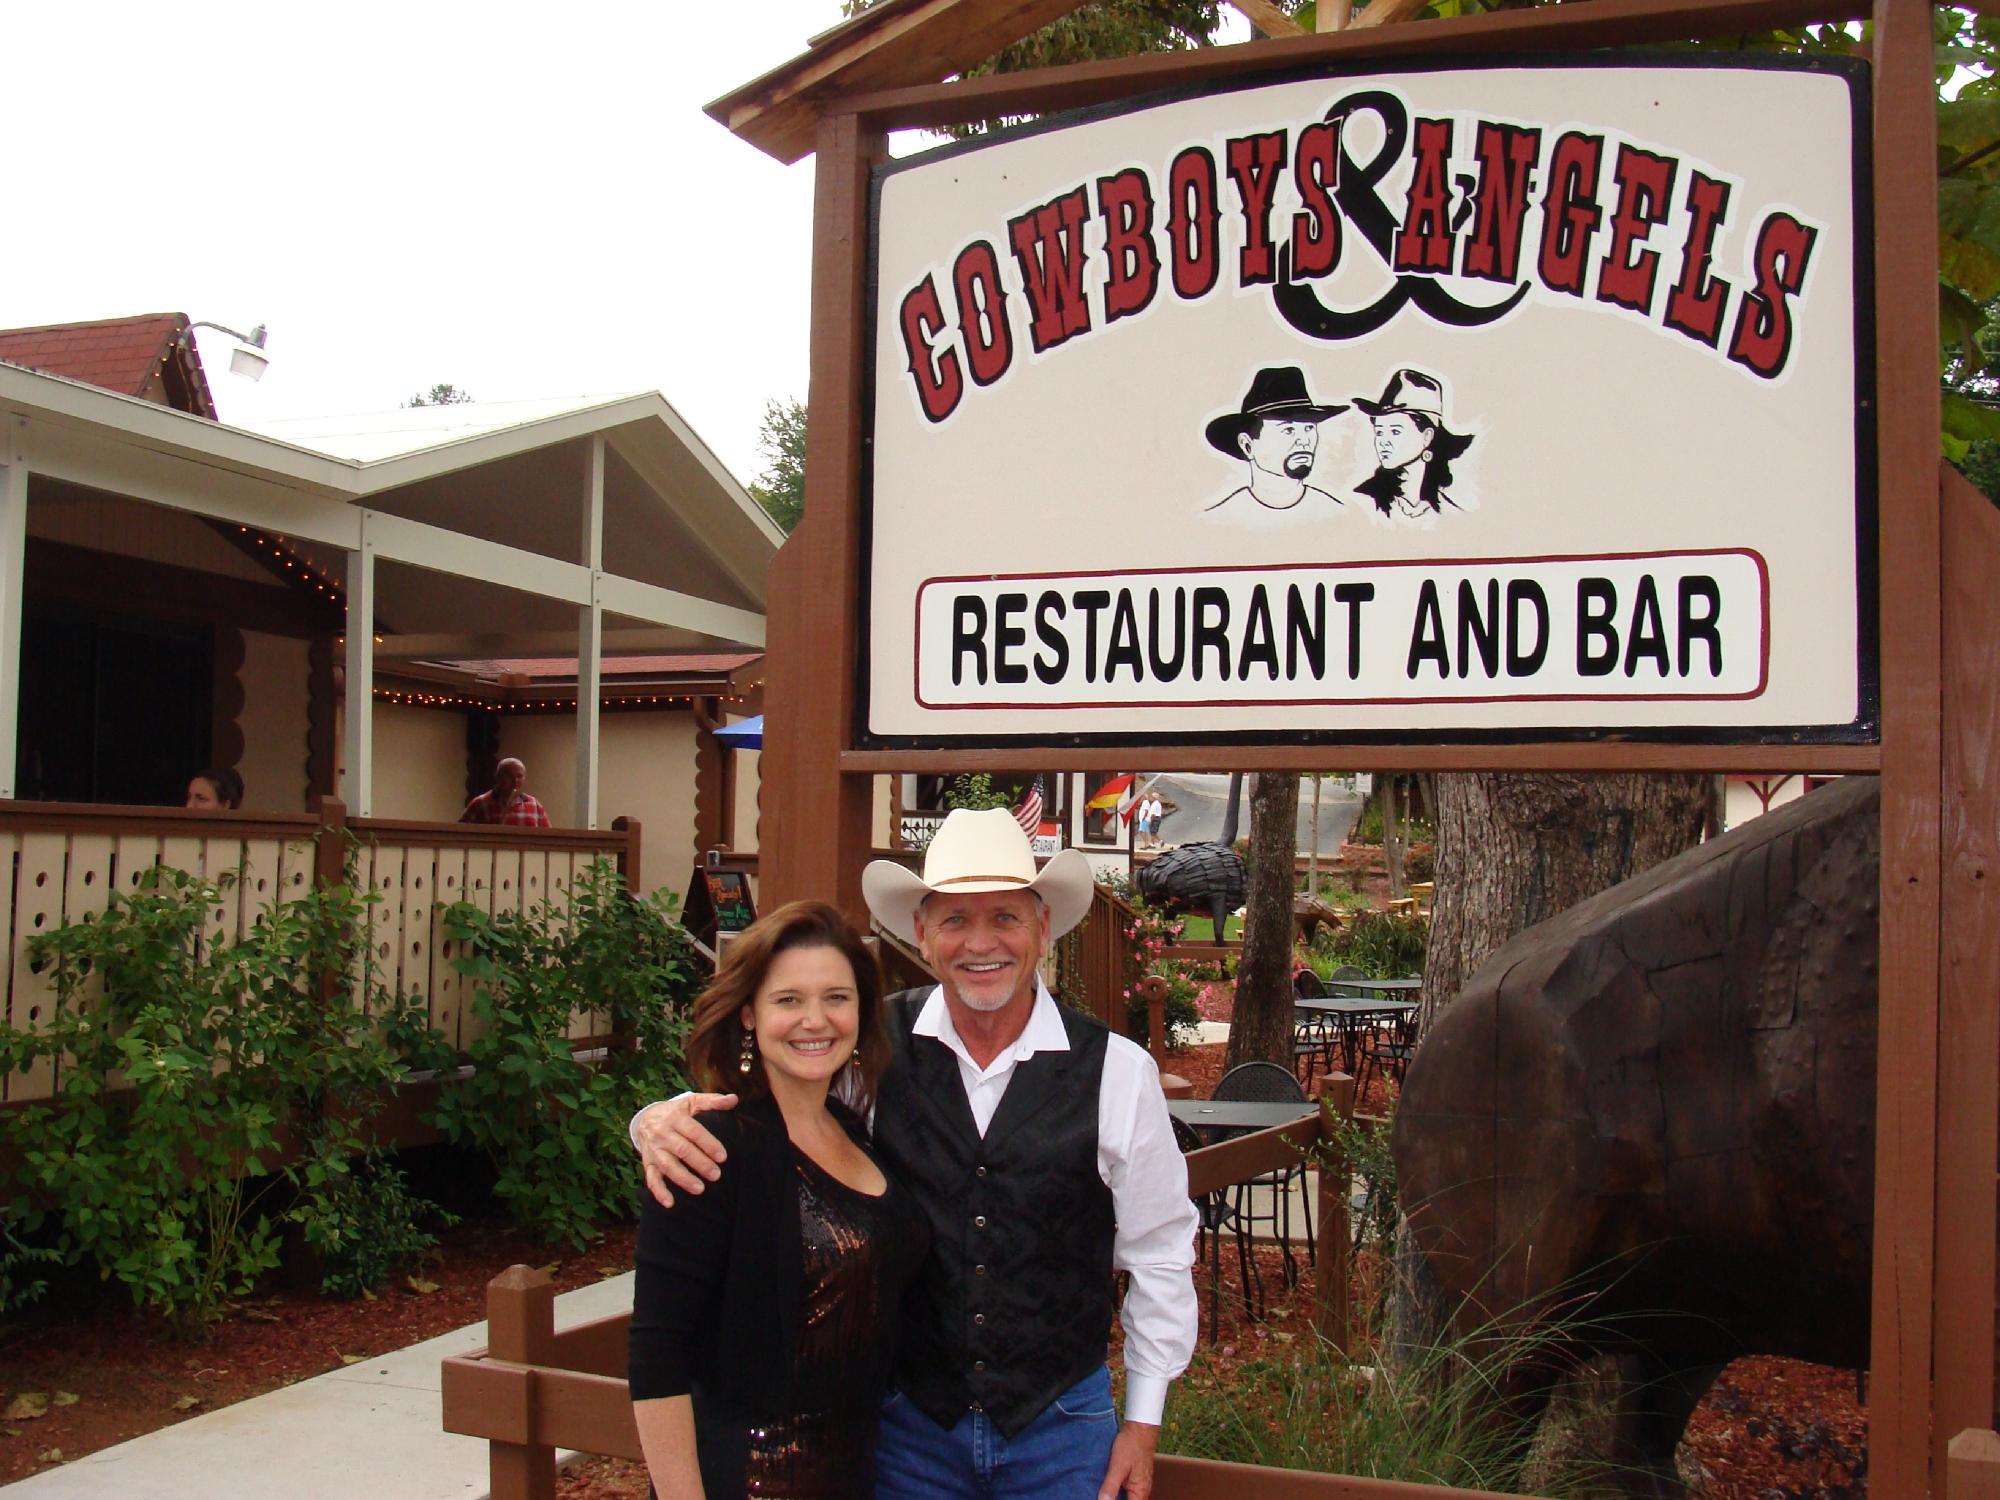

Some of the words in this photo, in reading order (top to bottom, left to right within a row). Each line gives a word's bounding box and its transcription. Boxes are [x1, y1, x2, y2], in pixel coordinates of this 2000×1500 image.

[900, 116, 1343, 424] COWBOYS
[1272, 91, 1532, 340] &
[1392, 116, 1819, 381] ANGELS
[951, 582, 1375, 686] RESTAURANT
[1406, 578, 1550, 680] AND
[1576, 574, 1724, 679] BAR
